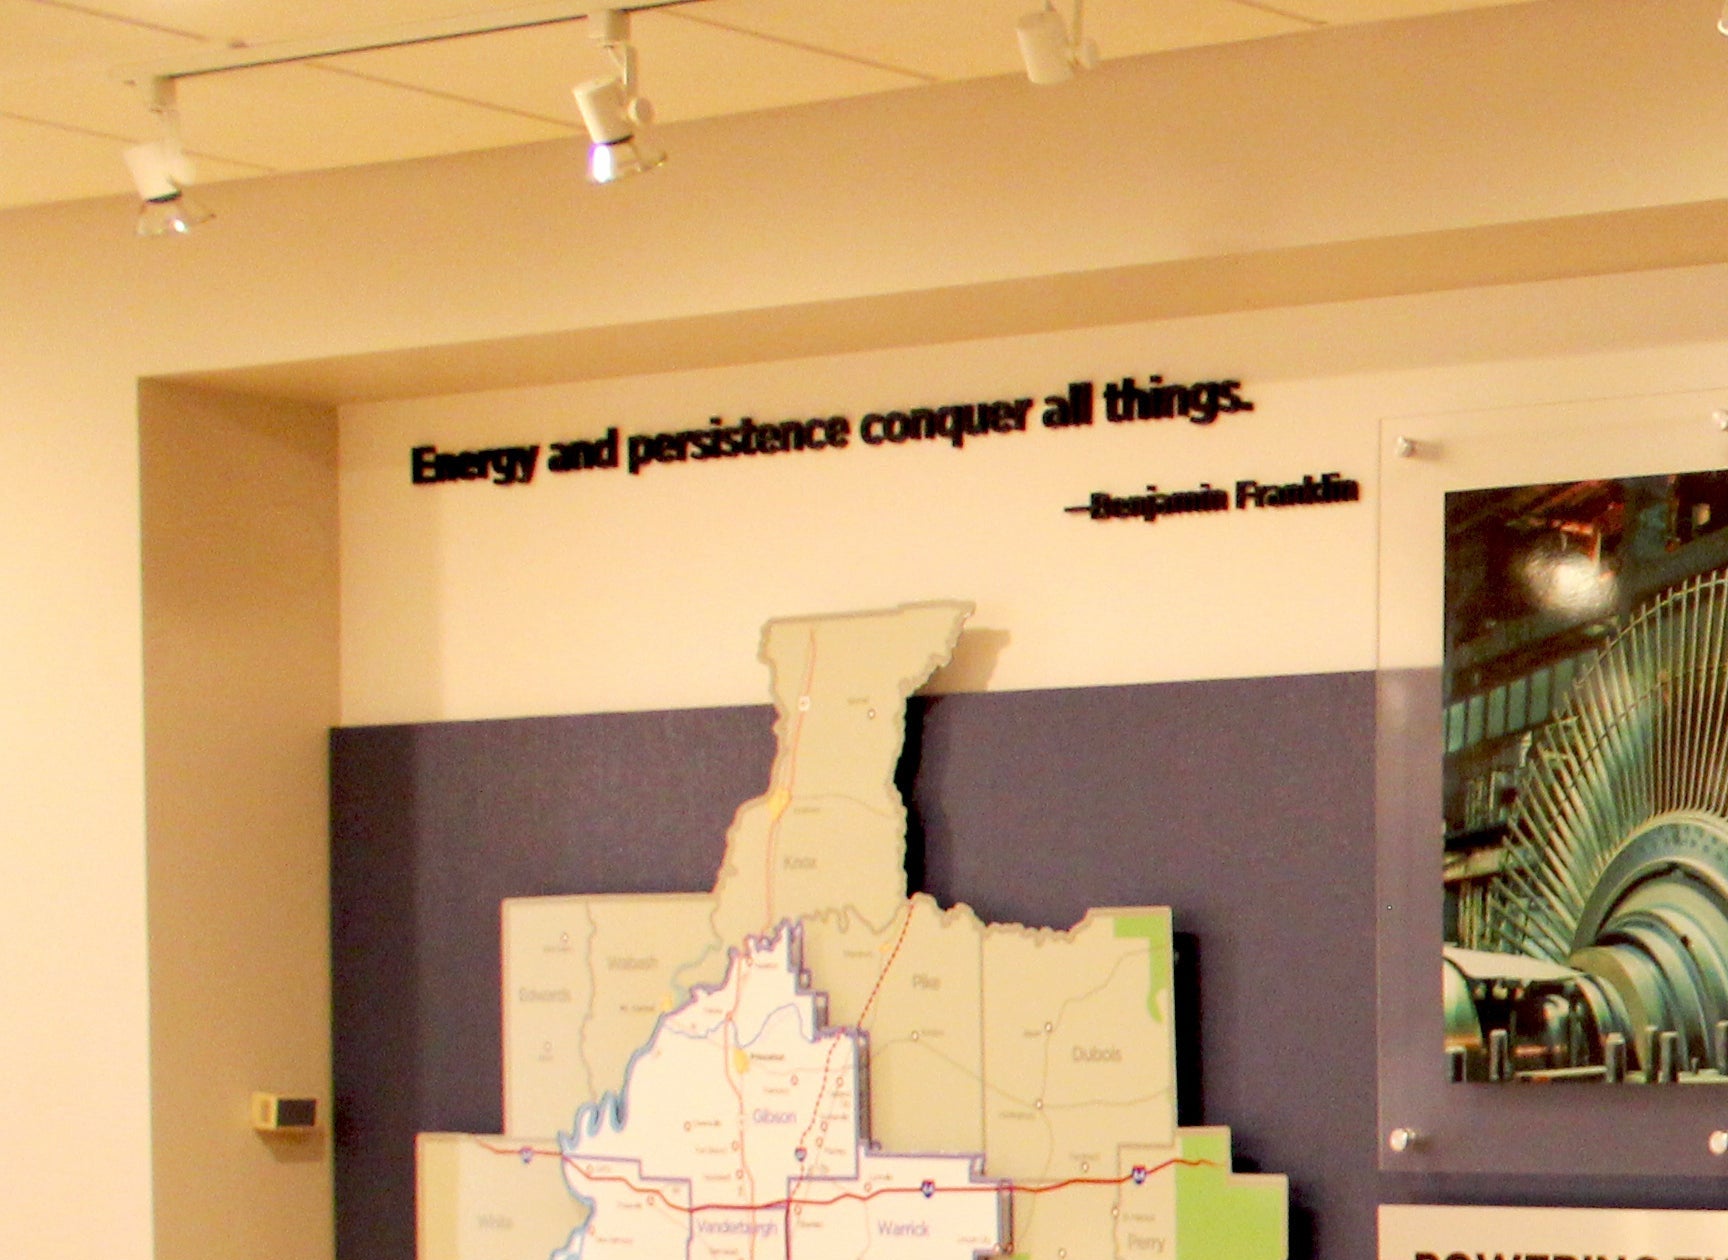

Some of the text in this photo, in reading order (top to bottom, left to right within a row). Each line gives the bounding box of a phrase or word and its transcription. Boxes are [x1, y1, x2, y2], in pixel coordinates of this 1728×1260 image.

[411, 373, 1255, 487] Energy and persistence conquer all things.
[1235, 471, 1360, 511] Franklin
[752, 1109, 798, 1125] Gibson
[698, 1220, 778, 1238] Vanderburgh
[877, 1219, 930, 1237] Warrick
[1128, 1234, 1166, 1254] Perry
